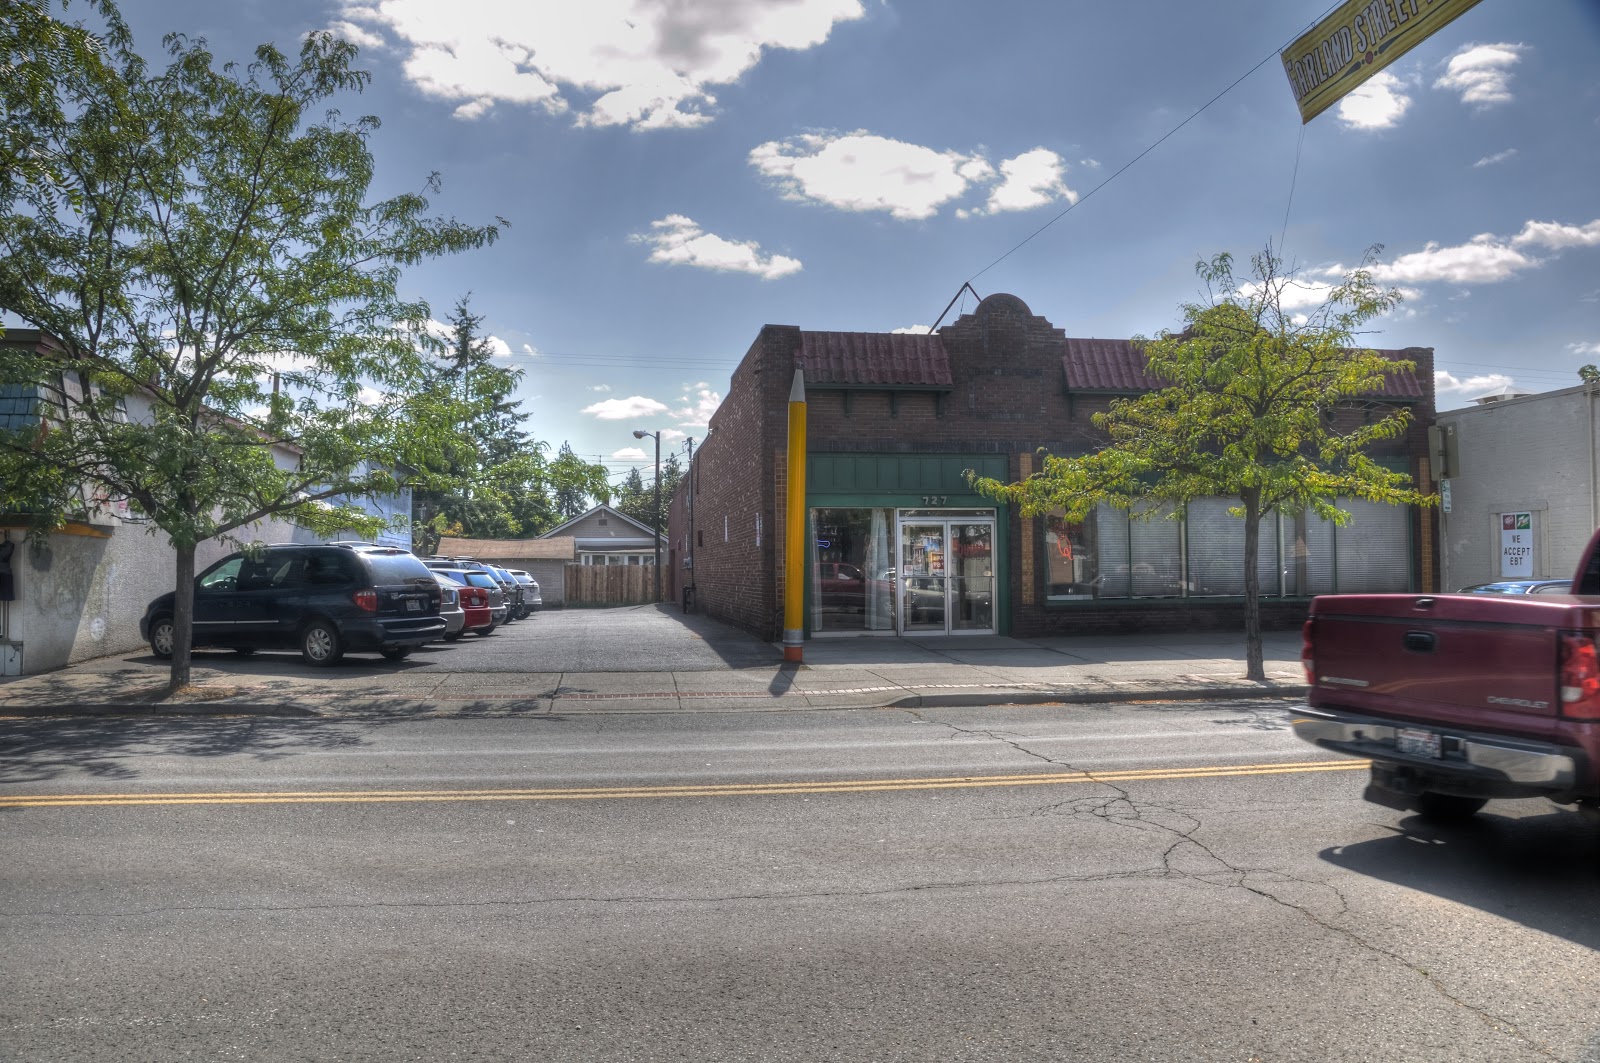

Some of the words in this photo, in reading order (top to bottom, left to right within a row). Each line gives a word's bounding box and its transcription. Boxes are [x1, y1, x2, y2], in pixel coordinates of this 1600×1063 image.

[923, 496, 947, 505] 727
[1512, 535, 1521, 544] WE
[1504, 547, 1530, 556] ACCEPT
[1510, 557, 1523, 566] EBT
